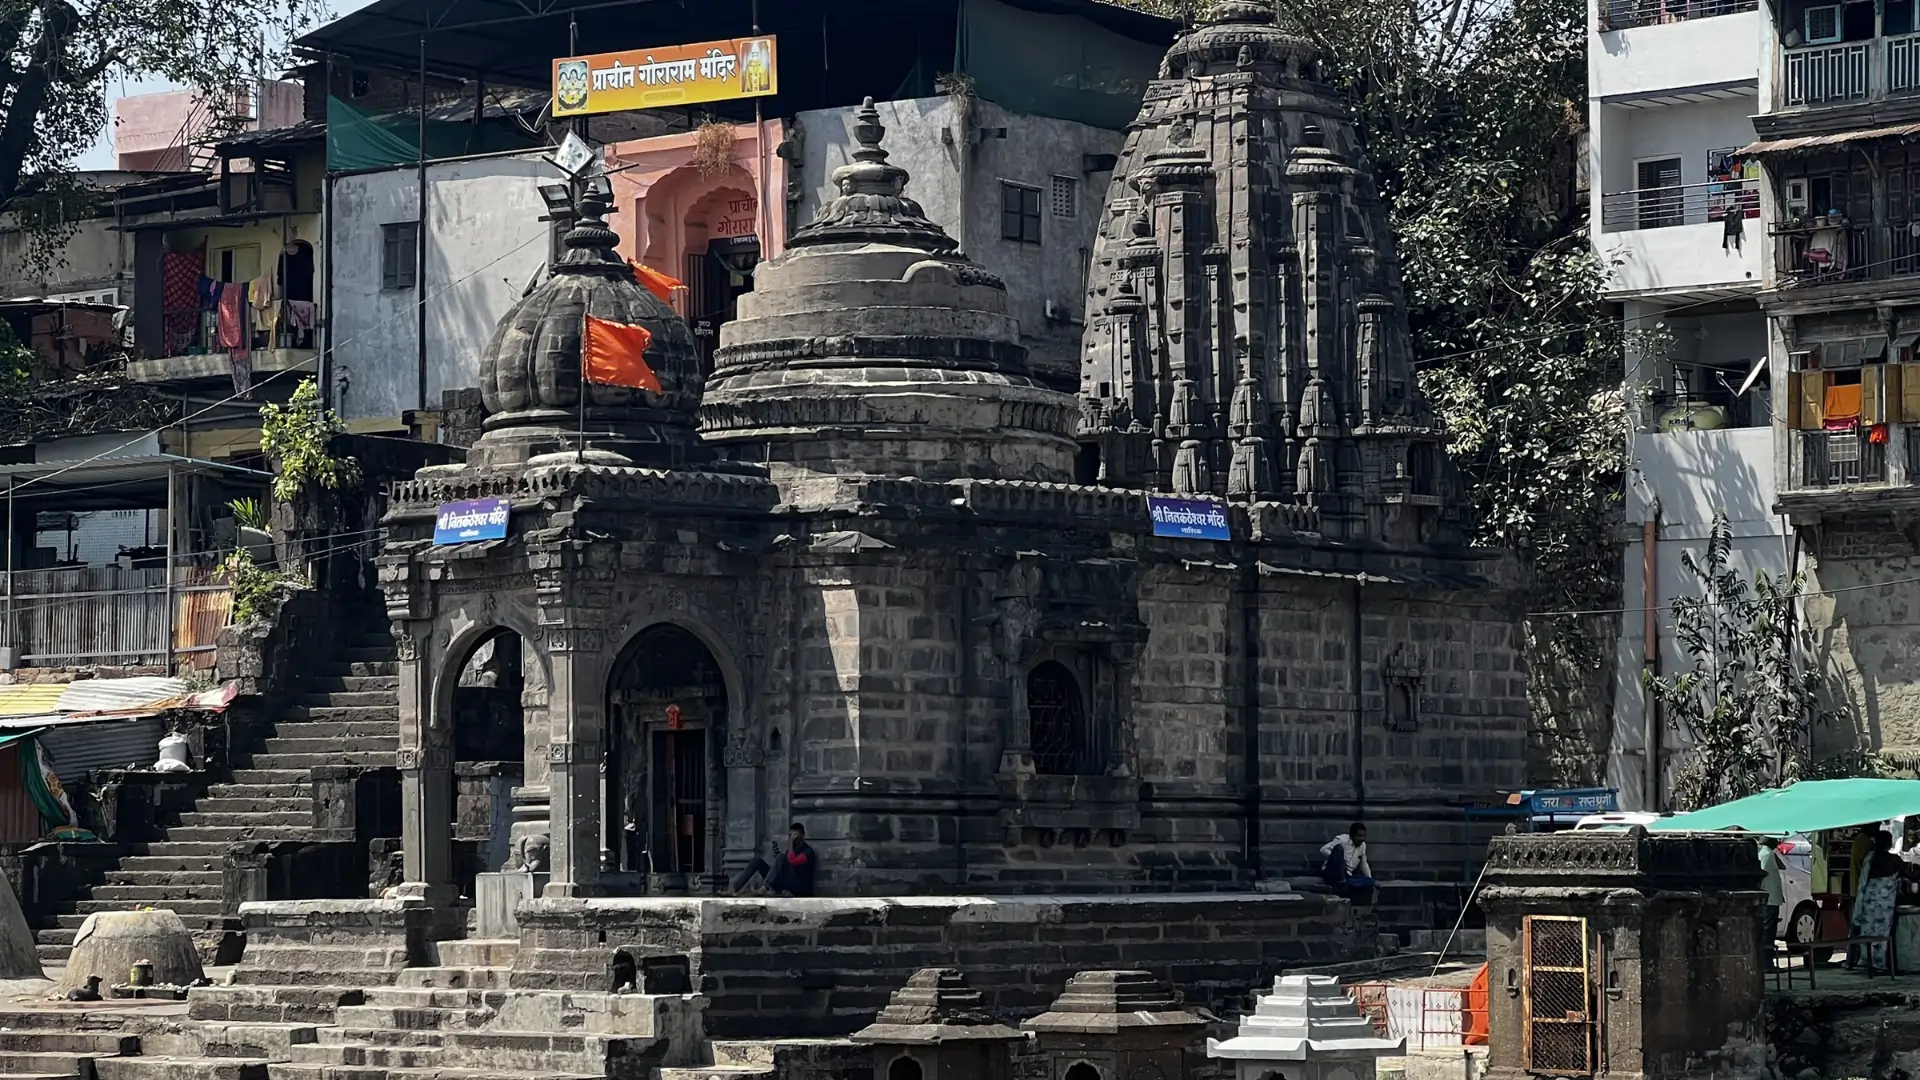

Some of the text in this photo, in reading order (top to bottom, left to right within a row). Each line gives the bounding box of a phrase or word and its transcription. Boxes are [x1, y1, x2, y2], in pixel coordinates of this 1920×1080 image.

[591, 48, 737, 92] प्राचीन गोराराम मंदिर
[717, 215, 756, 235] गोरारा
[1152, 505, 1164, 523] श्री
[1206, 509, 1226, 528] मंदिर
[1540, 797, 1560, 808] जय
